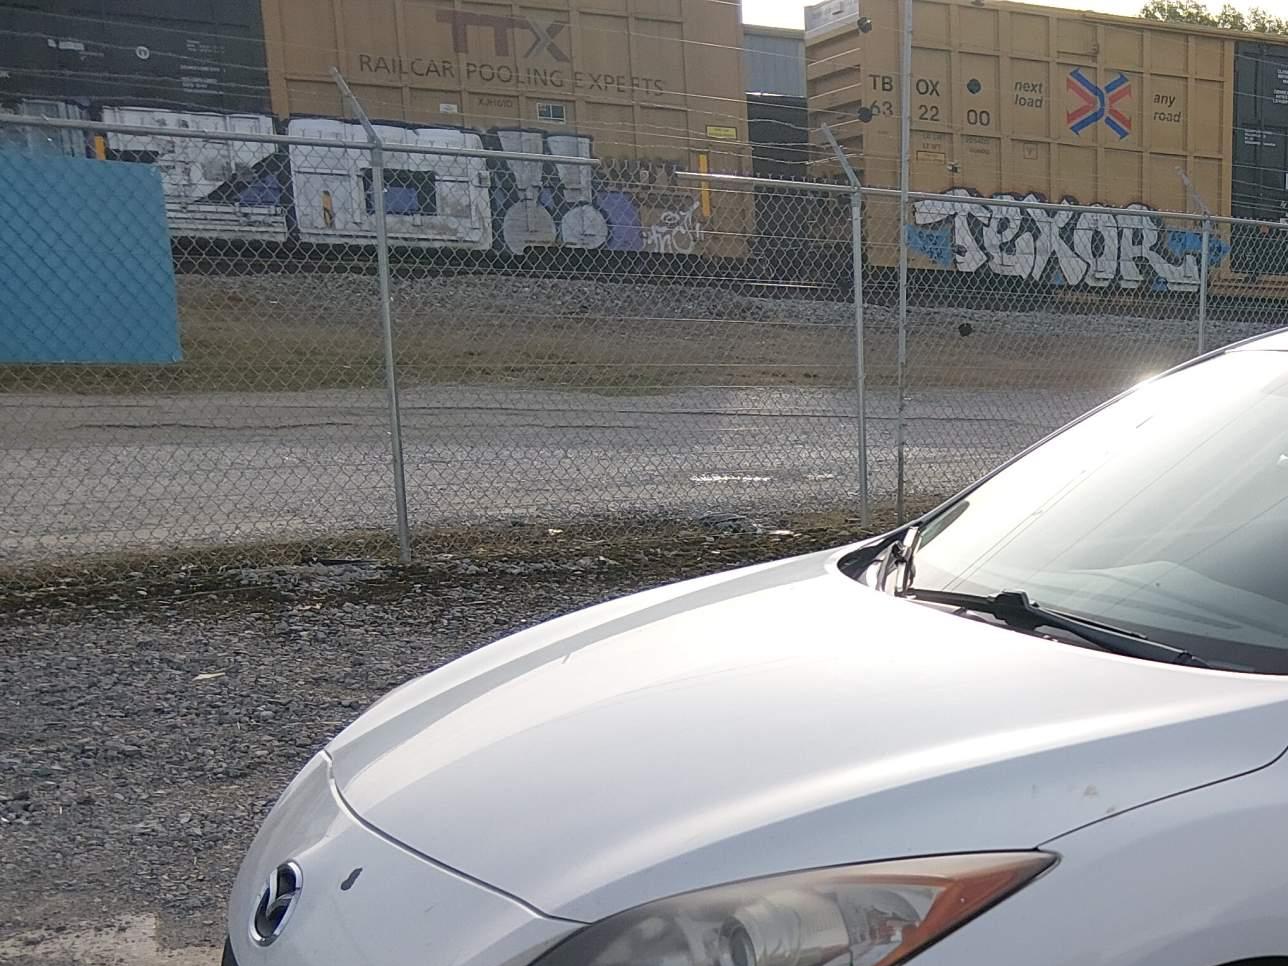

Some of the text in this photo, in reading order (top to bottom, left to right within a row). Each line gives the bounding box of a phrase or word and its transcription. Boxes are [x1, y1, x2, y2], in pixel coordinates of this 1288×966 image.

[436, 9, 571, 63] TTX
[359, 54, 665, 97] RAILCAR POOLING EXPERTS
[869, 74, 940, 97] TB OX
[1014, 80, 1044, 94] next
[1014, 94, 1044, 109] load
[1153, 94, 1176, 108] any
[870, 100, 991, 126] 63 22 00
[1153, 110, 1182, 123] road
